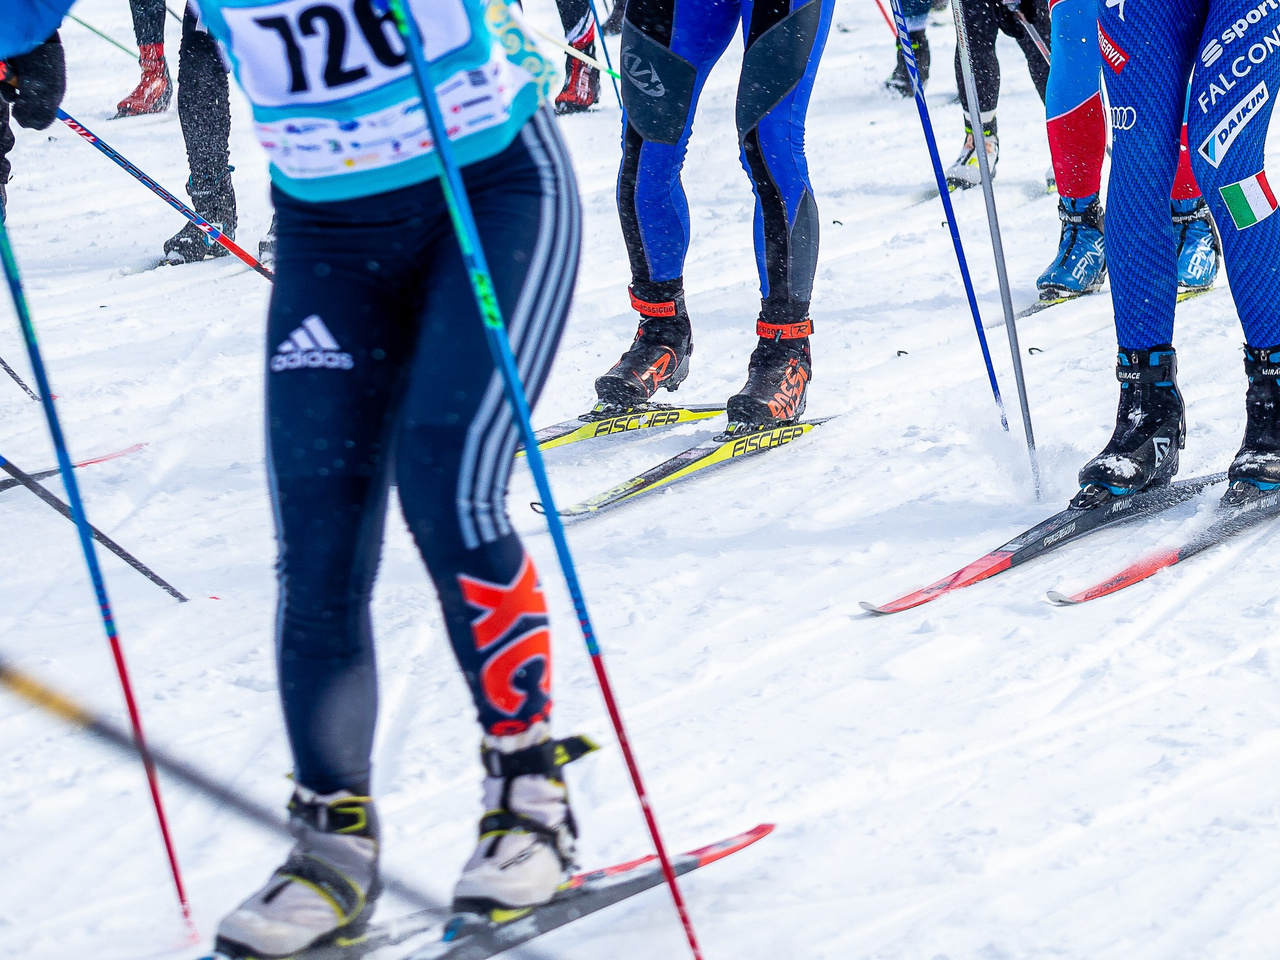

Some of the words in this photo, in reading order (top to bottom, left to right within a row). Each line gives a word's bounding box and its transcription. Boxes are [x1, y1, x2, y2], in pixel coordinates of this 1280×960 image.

[1217, 87, 1268, 147] DAIKIN
[270, 351, 355, 373] adidas
[594, 411, 681, 438] FISCHER
[731, 426, 805, 458] FISCHER
[1111, 498, 1133, 513] ATOMIC
